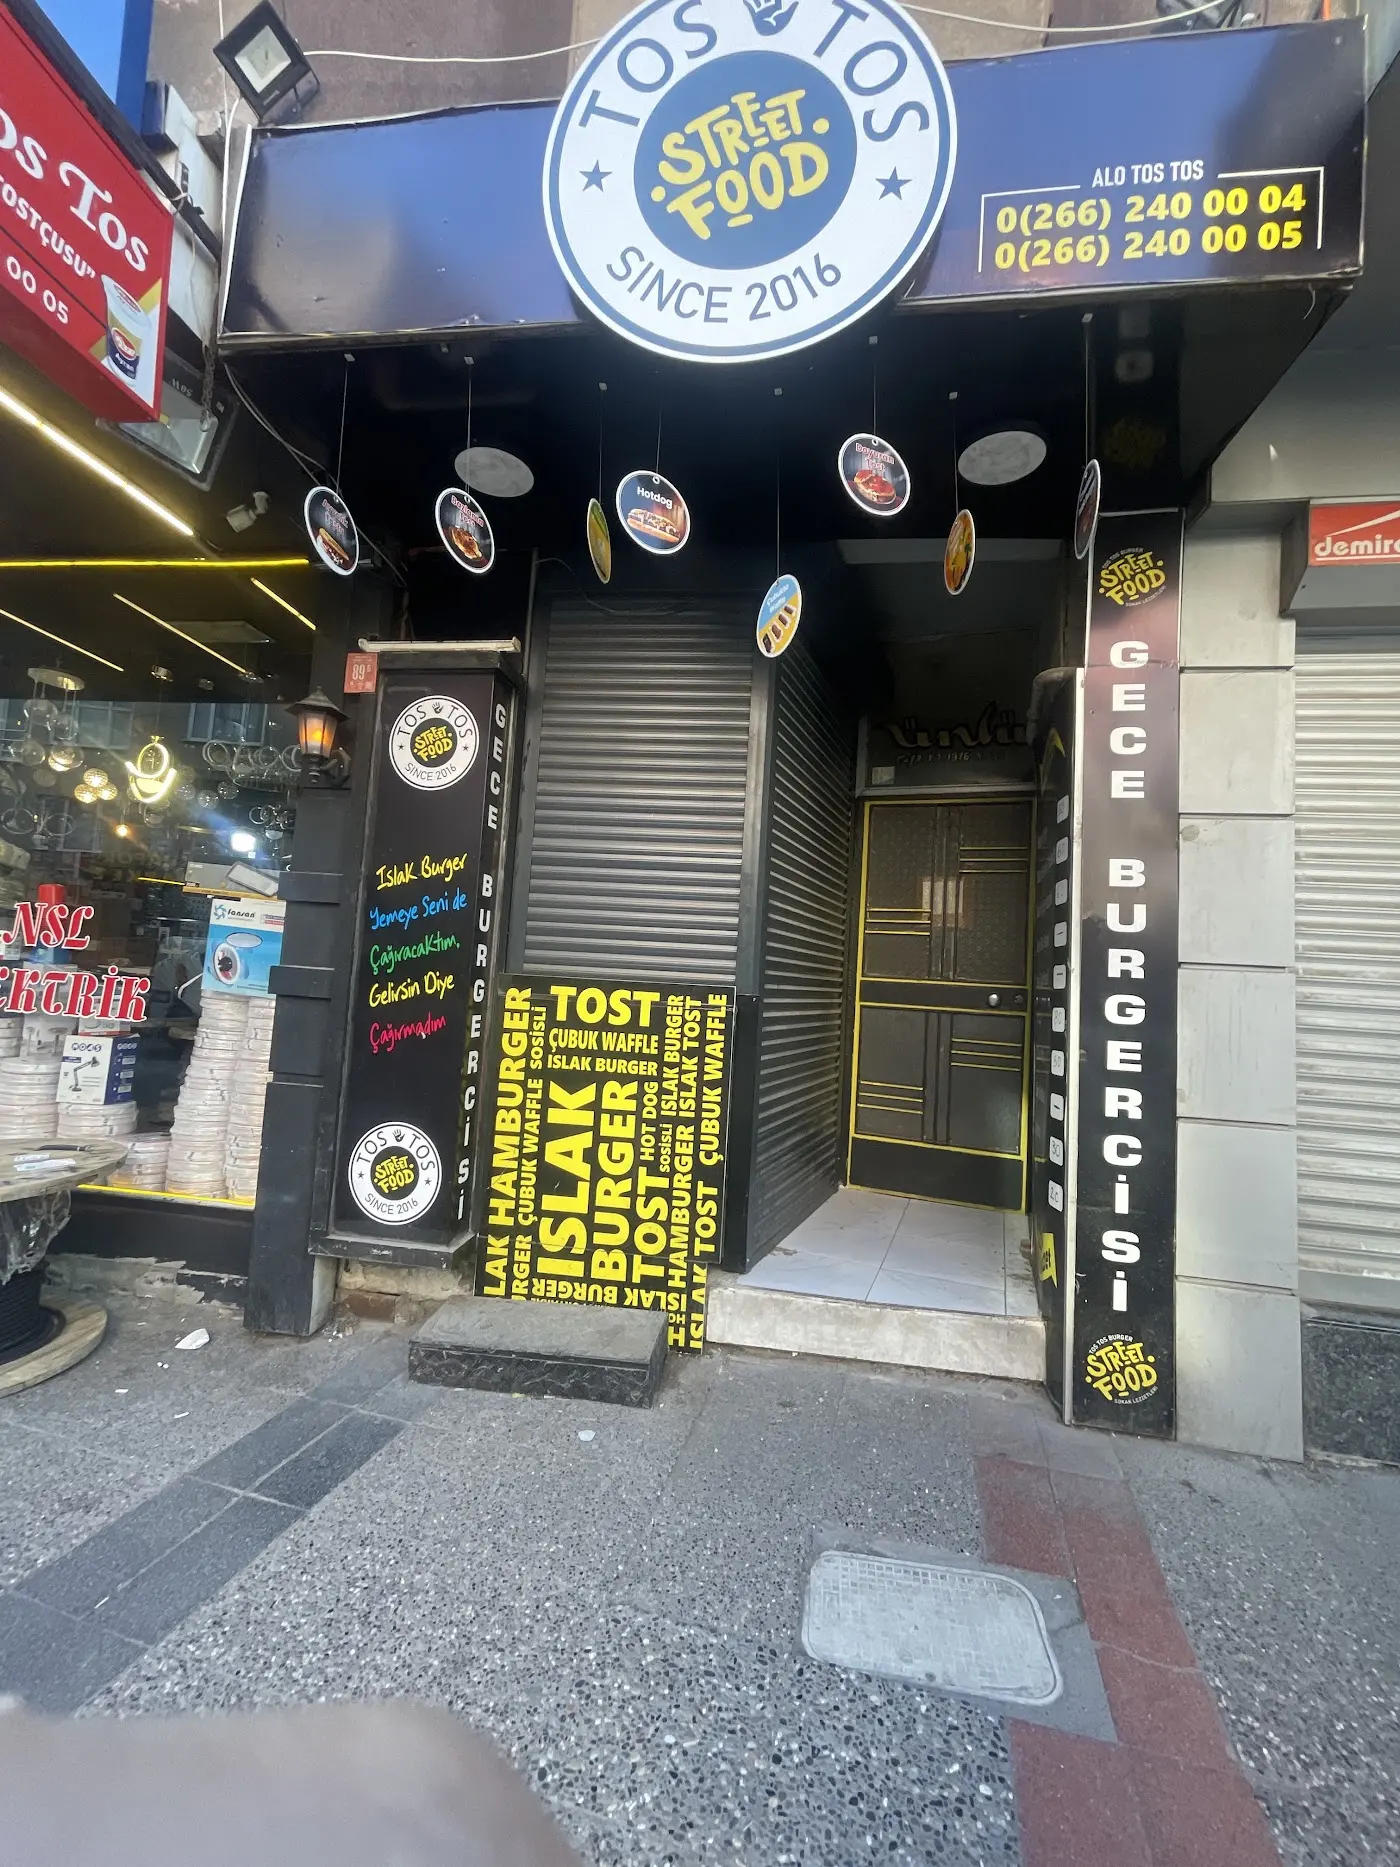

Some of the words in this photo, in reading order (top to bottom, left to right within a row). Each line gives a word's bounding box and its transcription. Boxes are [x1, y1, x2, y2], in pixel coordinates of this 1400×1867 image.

[578, 0, 718, 128] TOS
[813, 0, 930, 142] TOS
[658, 89, 806, 185] STREET
[666, 141, 829, 240] FOOD
[1091, 166, 1126, 188] ALO
[1130, 162, 1165, 186] TOS
[1170, 159, 1204, 182] TOS
[995, 197, 1112, 237] 0(266)
[1124, 191, 1192, 224] 240
[1202, 186, 1249, 218] 00
[1258, 183, 1307, 214] 04
[994, 233, 1110, 273] 0(266)
[1122, 227, 1191, 260] 240
[1201, 223, 1248, 254] 00
[1257, 220, 1303, 251] 05
[6, 255, 37, 294] 00
[42, 289, 69, 325] 05
[606, 245, 733, 323] SINCE
[745, 252, 842, 321] 2016
[855, 442, 895, 465] Doyuran
[636, 485, 673, 511] Hotdog
[1100, 551, 1153, 588] STREET
[1105, 568, 1166, 606] FOOD
[352, 663, 365, 680] 89
[397, 704, 427, 736] TOS
[447, 704, 473, 738] TOS
[414, 726, 447, 750] STREET
[1109, 640, 1151, 801] GECE
[417, 737, 453, 762] FOOD
[487, 703, 507, 831] GECE
[404, 762, 434, 781] SINCE
[435, 763, 457, 780] 2016
[420, 853, 468, 882] Burger
[2, 901, 95, 950] NSL
[369, 904, 419, 930] Yemeye
[422, 891, 449, 918] Seni
[452, 886, 468, 911] de
[368, 977, 421, 1008] Gelirsin
[424, 970, 455, 1000] Diye
[550, 985, 661, 1027] TOST
[369, 1010, 447, 1054] Çağırmadım
[548, 1027, 599, 1053] ÇUBUK
[601, 1030, 659, 1055] WAFFLE
[663, 994, 684, 1063] BURGER
[682, 995, 702, 1051] TOST
[703, 993, 728, 1081] WAFFLE
[547, 1054, 592, 1072] ISLAK
[595, 1057, 659, 1076] BURGER
[678, 1055, 699, 1118] ISLAK
[488, 987, 532, 1226] HAMBURGER
[642, 1081, 659, 1119] DOG
[660, 1066, 680, 1116] ISLAK
[522, 1078, 543, 1154] WAFFLE
[698, 1085, 724, 1166] ÇUBUK
[356, 1130, 387, 1163] TOS
[408, 1133, 436, 1171] TOS
[639, 1122, 657, 1161] HOT
[1051, 1140, 1061, 1158] 30
[375, 1155, 409, 1179] STREET
[377, 1168, 415, 1194] FOOD
[537, 1080, 597, 1277] ISLAK
[591, 1080, 639, 1282] BURGER
[364, 1192, 394, 1215] SINCE
[397, 1197, 419, 1215] 2016
[517, 1157, 538, 1226] ÇUBUK
[667, 1124, 695, 1289] HAMBURGER
[631, 1166, 670, 1284] TOST
[694, 1180, 718, 1257] TOST
[483, 1234, 510, 1298] LAK
[532, 1277, 618, 1305] BURGER
[1086, 1341, 1145, 1377] STREET
[1088, 1343, 1099, 1355] TOS
[1096, 1336, 1108, 1346] TOS
[1108, 1333, 1134, 1343] BURGER
[1092, 1363, 1158, 1401] FOOD
